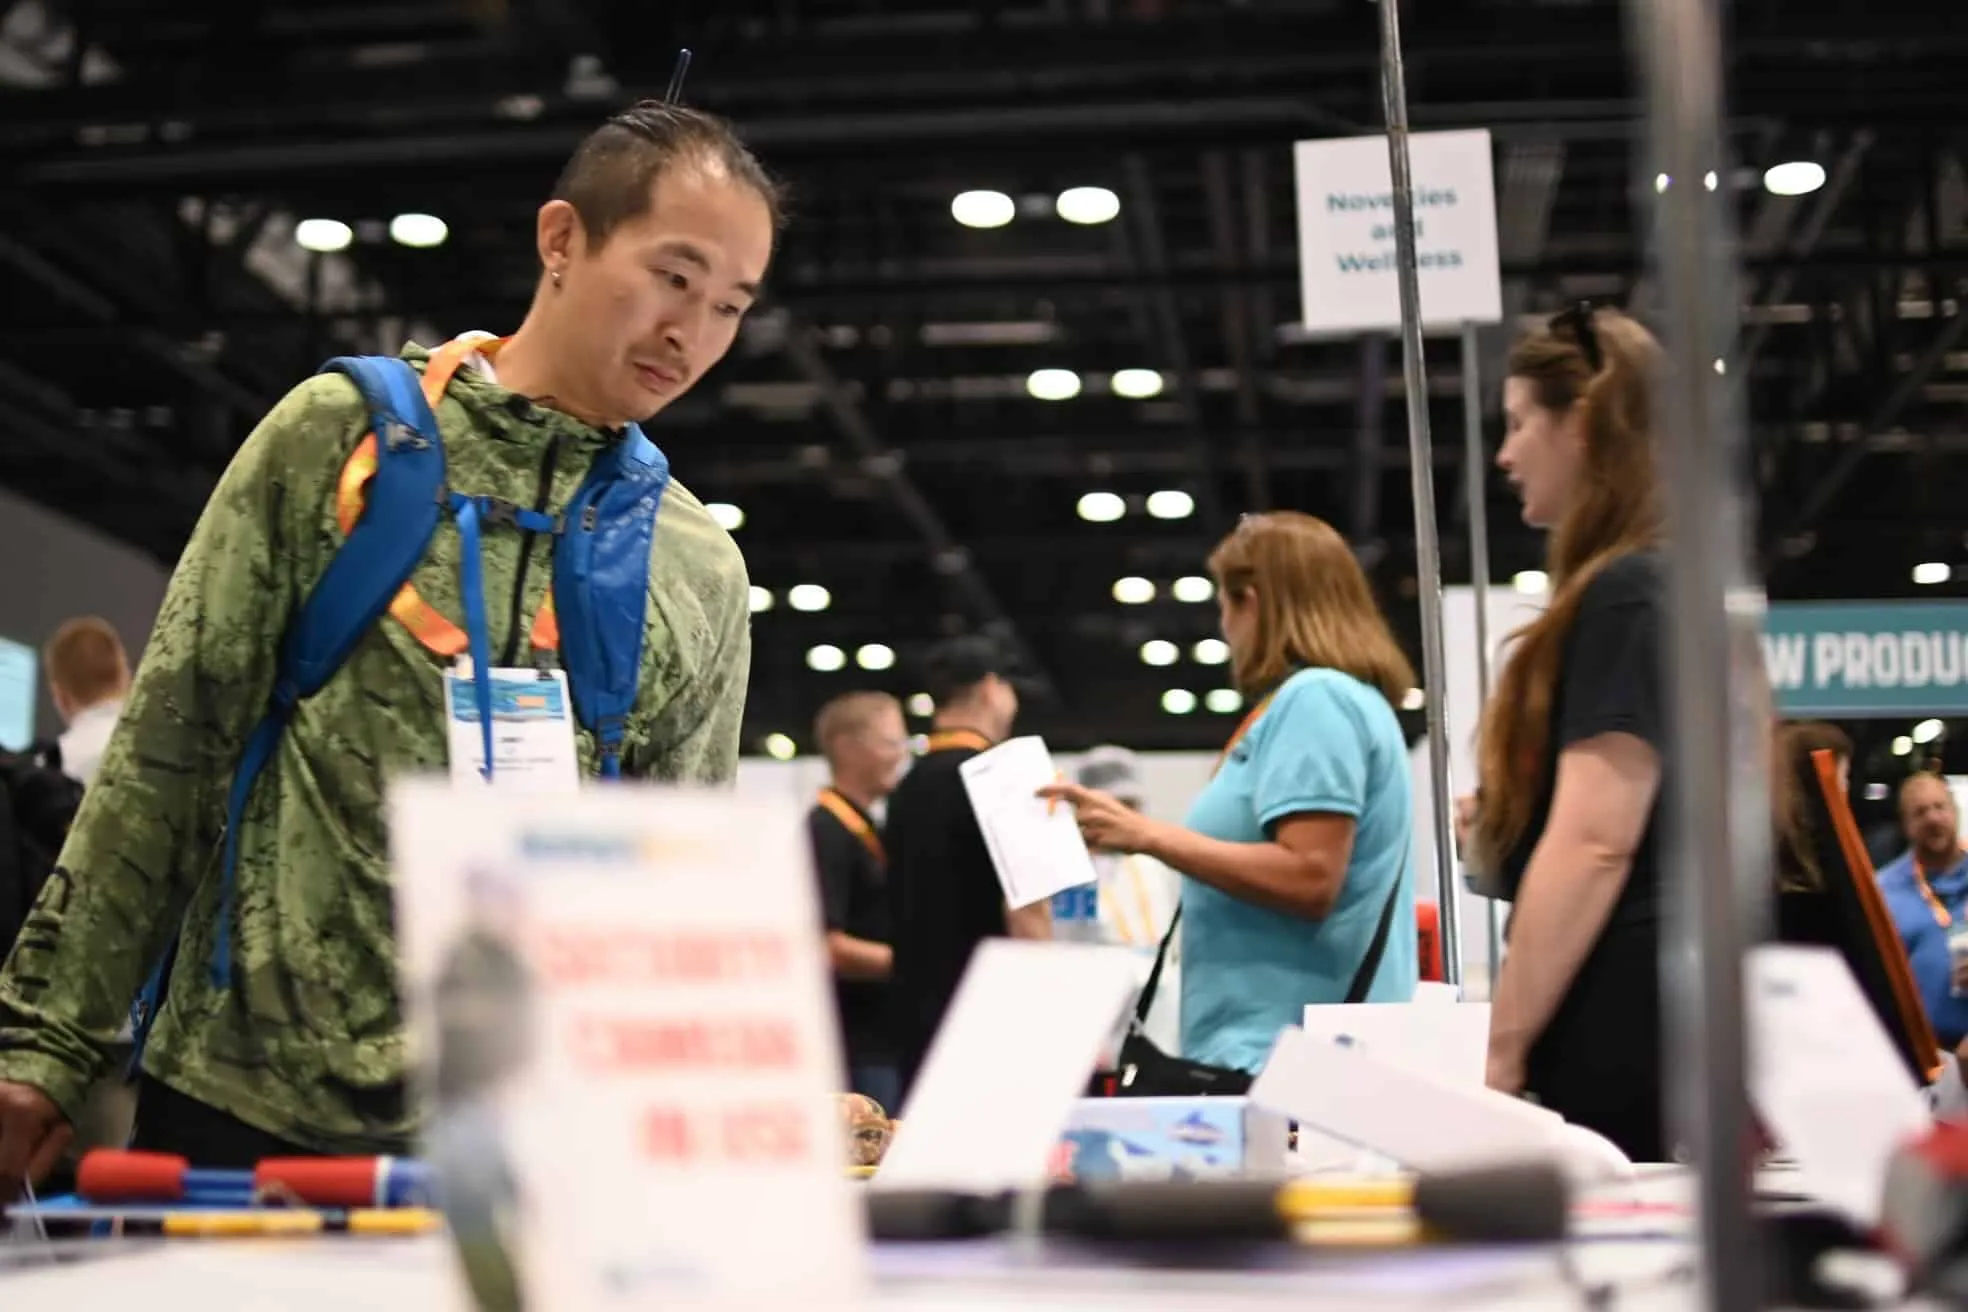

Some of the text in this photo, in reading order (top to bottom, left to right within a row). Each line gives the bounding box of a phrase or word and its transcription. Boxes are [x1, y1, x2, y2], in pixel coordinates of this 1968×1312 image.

[1326, 188, 1458, 213] Noveies
[1336, 250, 1463, 272] Welless
[1814, 631, 1968, 689] PRODU
